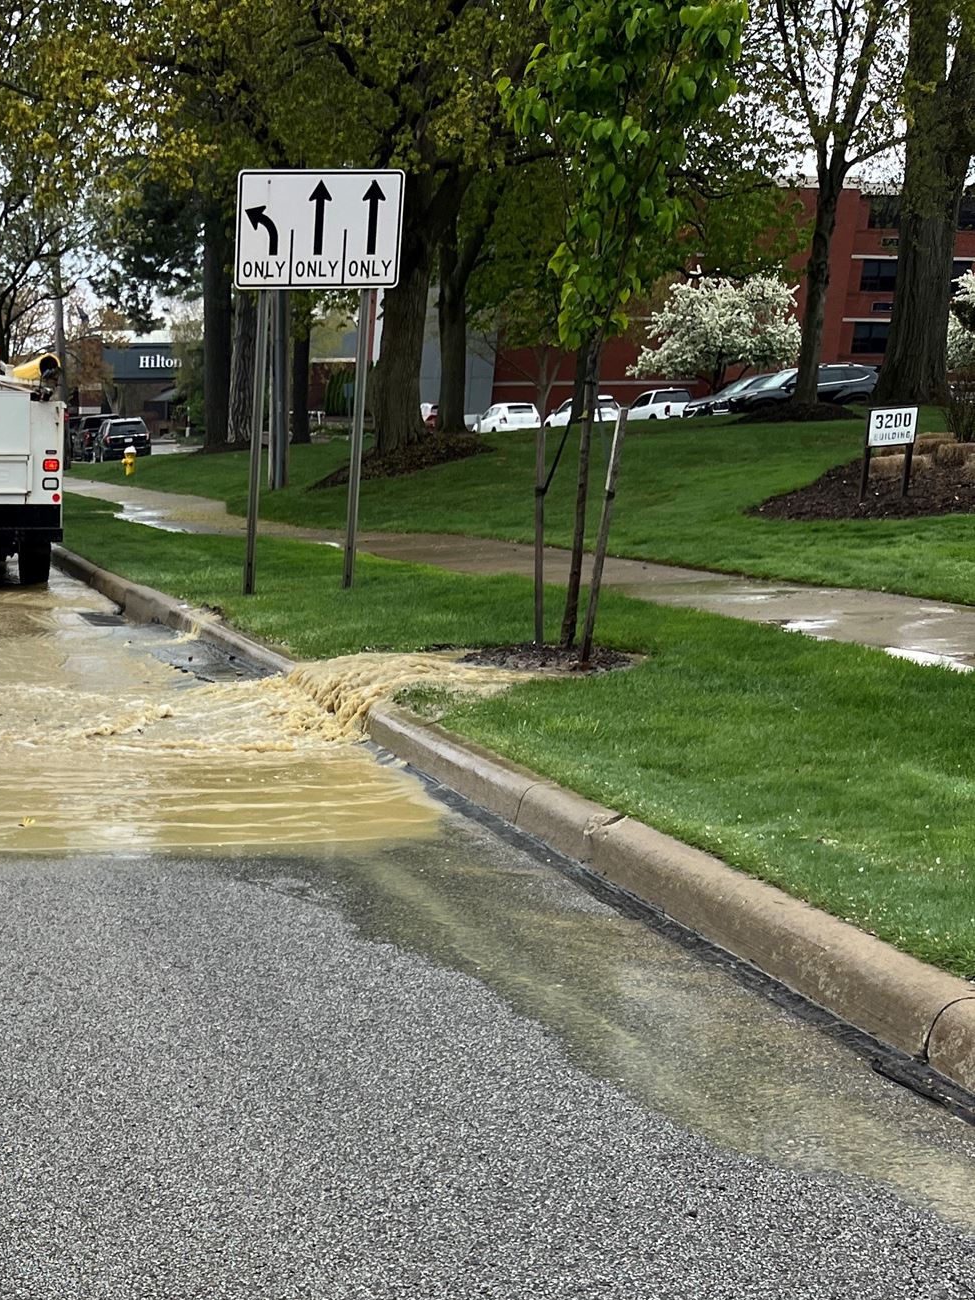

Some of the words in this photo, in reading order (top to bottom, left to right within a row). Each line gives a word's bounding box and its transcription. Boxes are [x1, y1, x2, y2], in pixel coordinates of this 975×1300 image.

[243, 261, 286, 279] ONLY
[295, 260, 338, 277] ONLY
[348, 259, 392, 278] ONLY
[139, 354, 183, 368] Hilton
[875, 412, 912, 429] 3200
